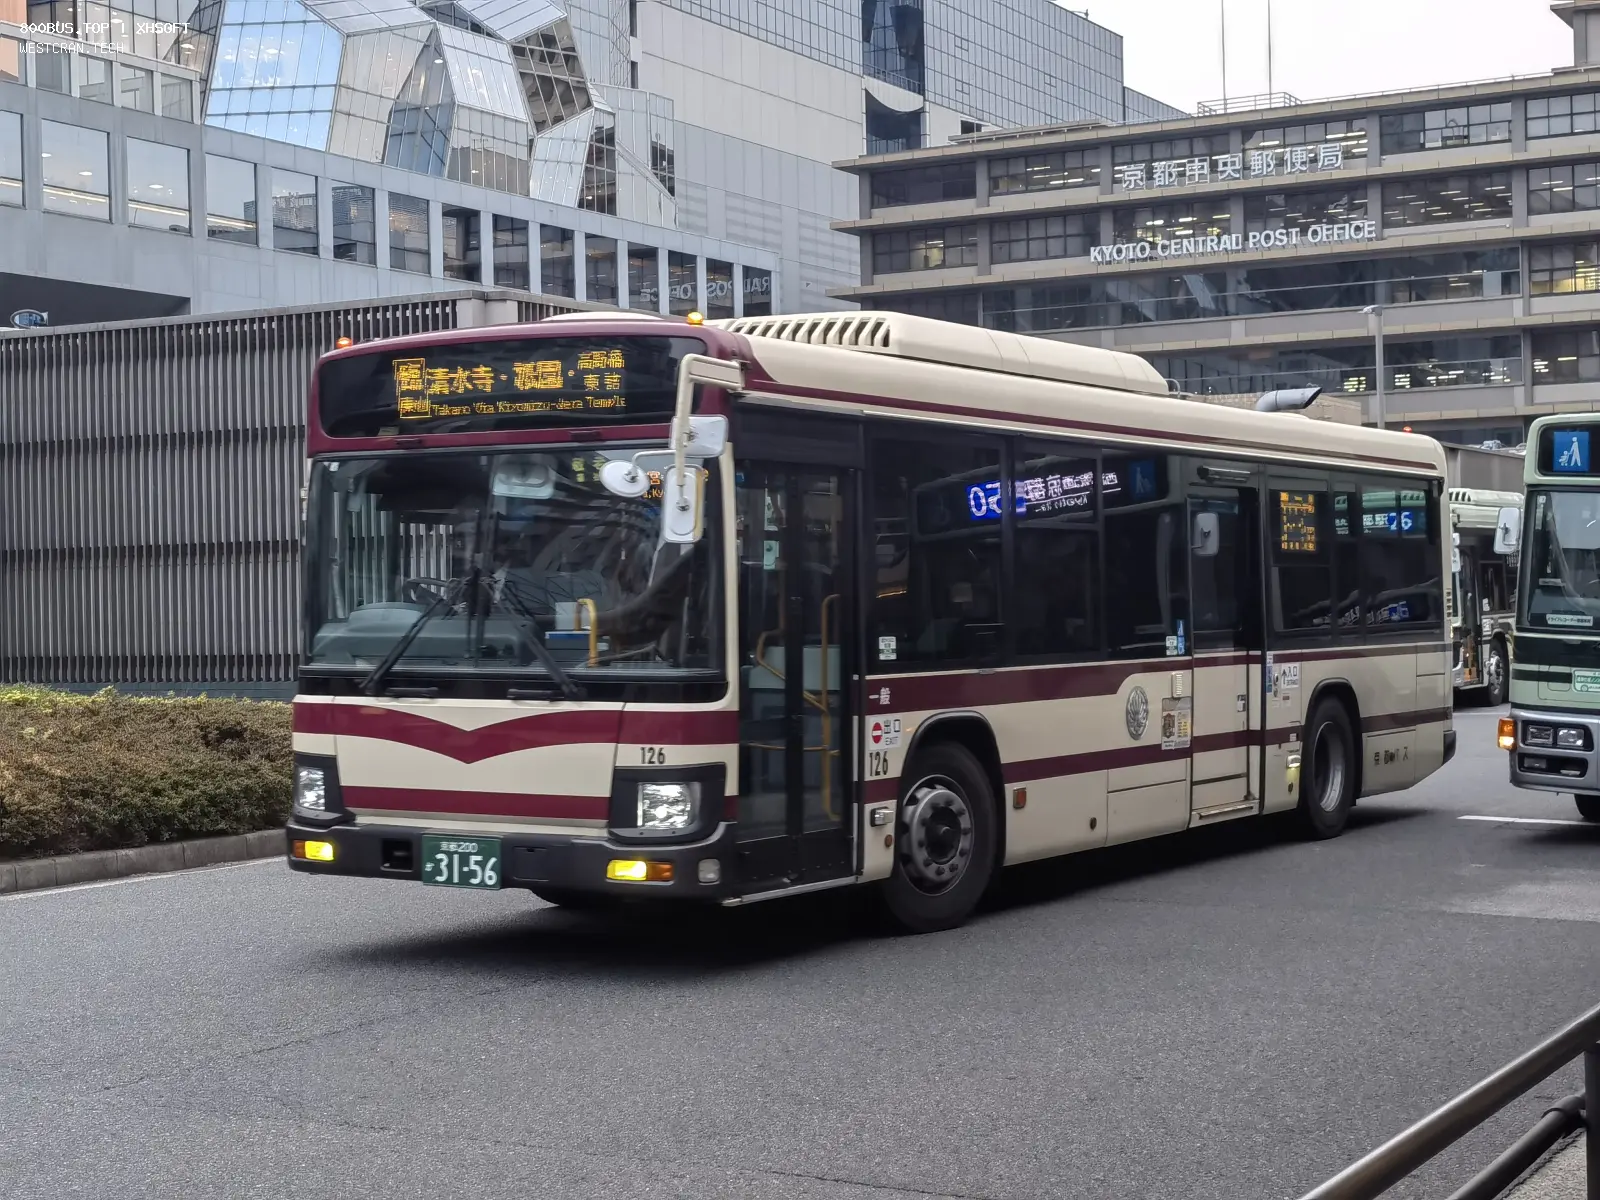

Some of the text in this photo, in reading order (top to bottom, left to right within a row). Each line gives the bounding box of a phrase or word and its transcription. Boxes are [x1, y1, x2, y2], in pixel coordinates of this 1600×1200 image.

[1122, 142, 1344, 189] 京都中央郵便局
[1090, 220, 1376, 262] KYOTO CENTRAL POST OFFICE
[884, 719, 900, 734] 出口
[640, 746, 666, 765] 126
[869, 751, 889, 777] 126
[435, 853, 498, 886] 31-56
